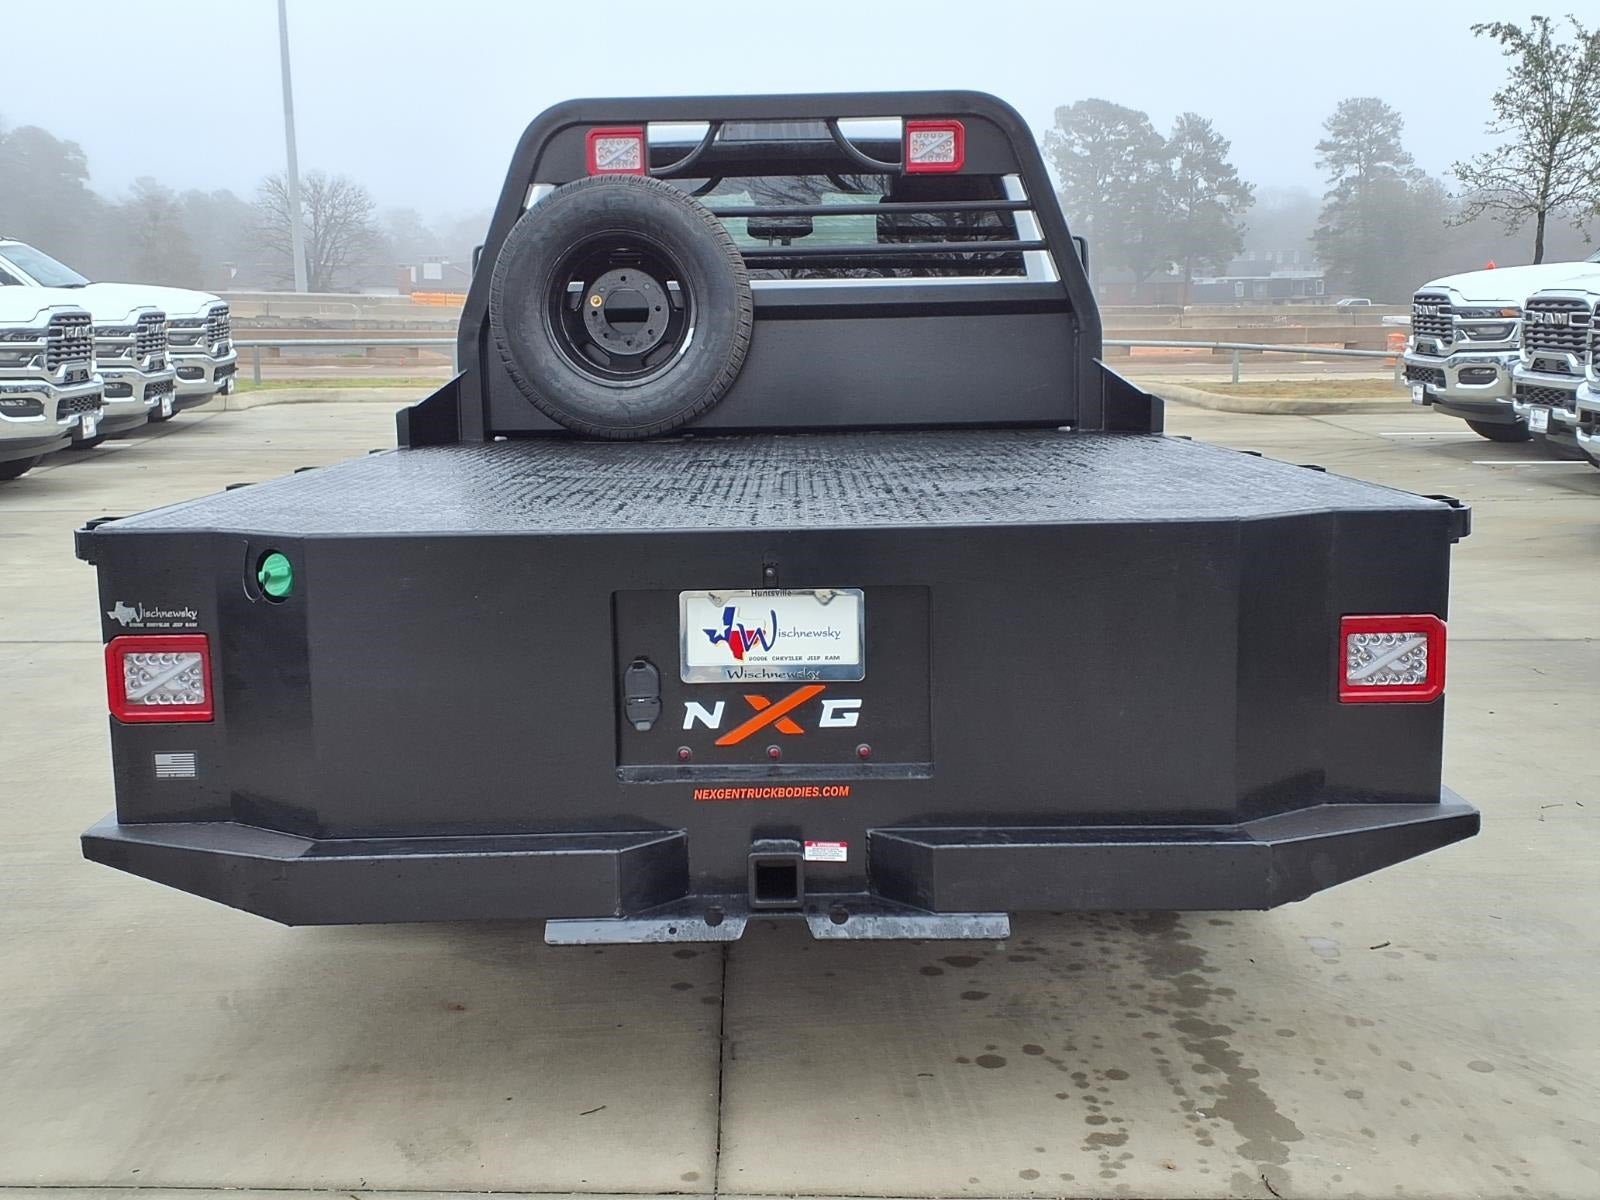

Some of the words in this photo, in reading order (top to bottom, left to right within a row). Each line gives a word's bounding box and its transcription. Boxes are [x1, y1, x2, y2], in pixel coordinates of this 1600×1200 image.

[1533, 312, 1568, 325] RAM
[737, 609, 841, 652] Wischnewsky
[727, 666, 820, 680] Wischnewsky
[693, 786, 850, 800] NEXGENTRUCKBODIES.COM
